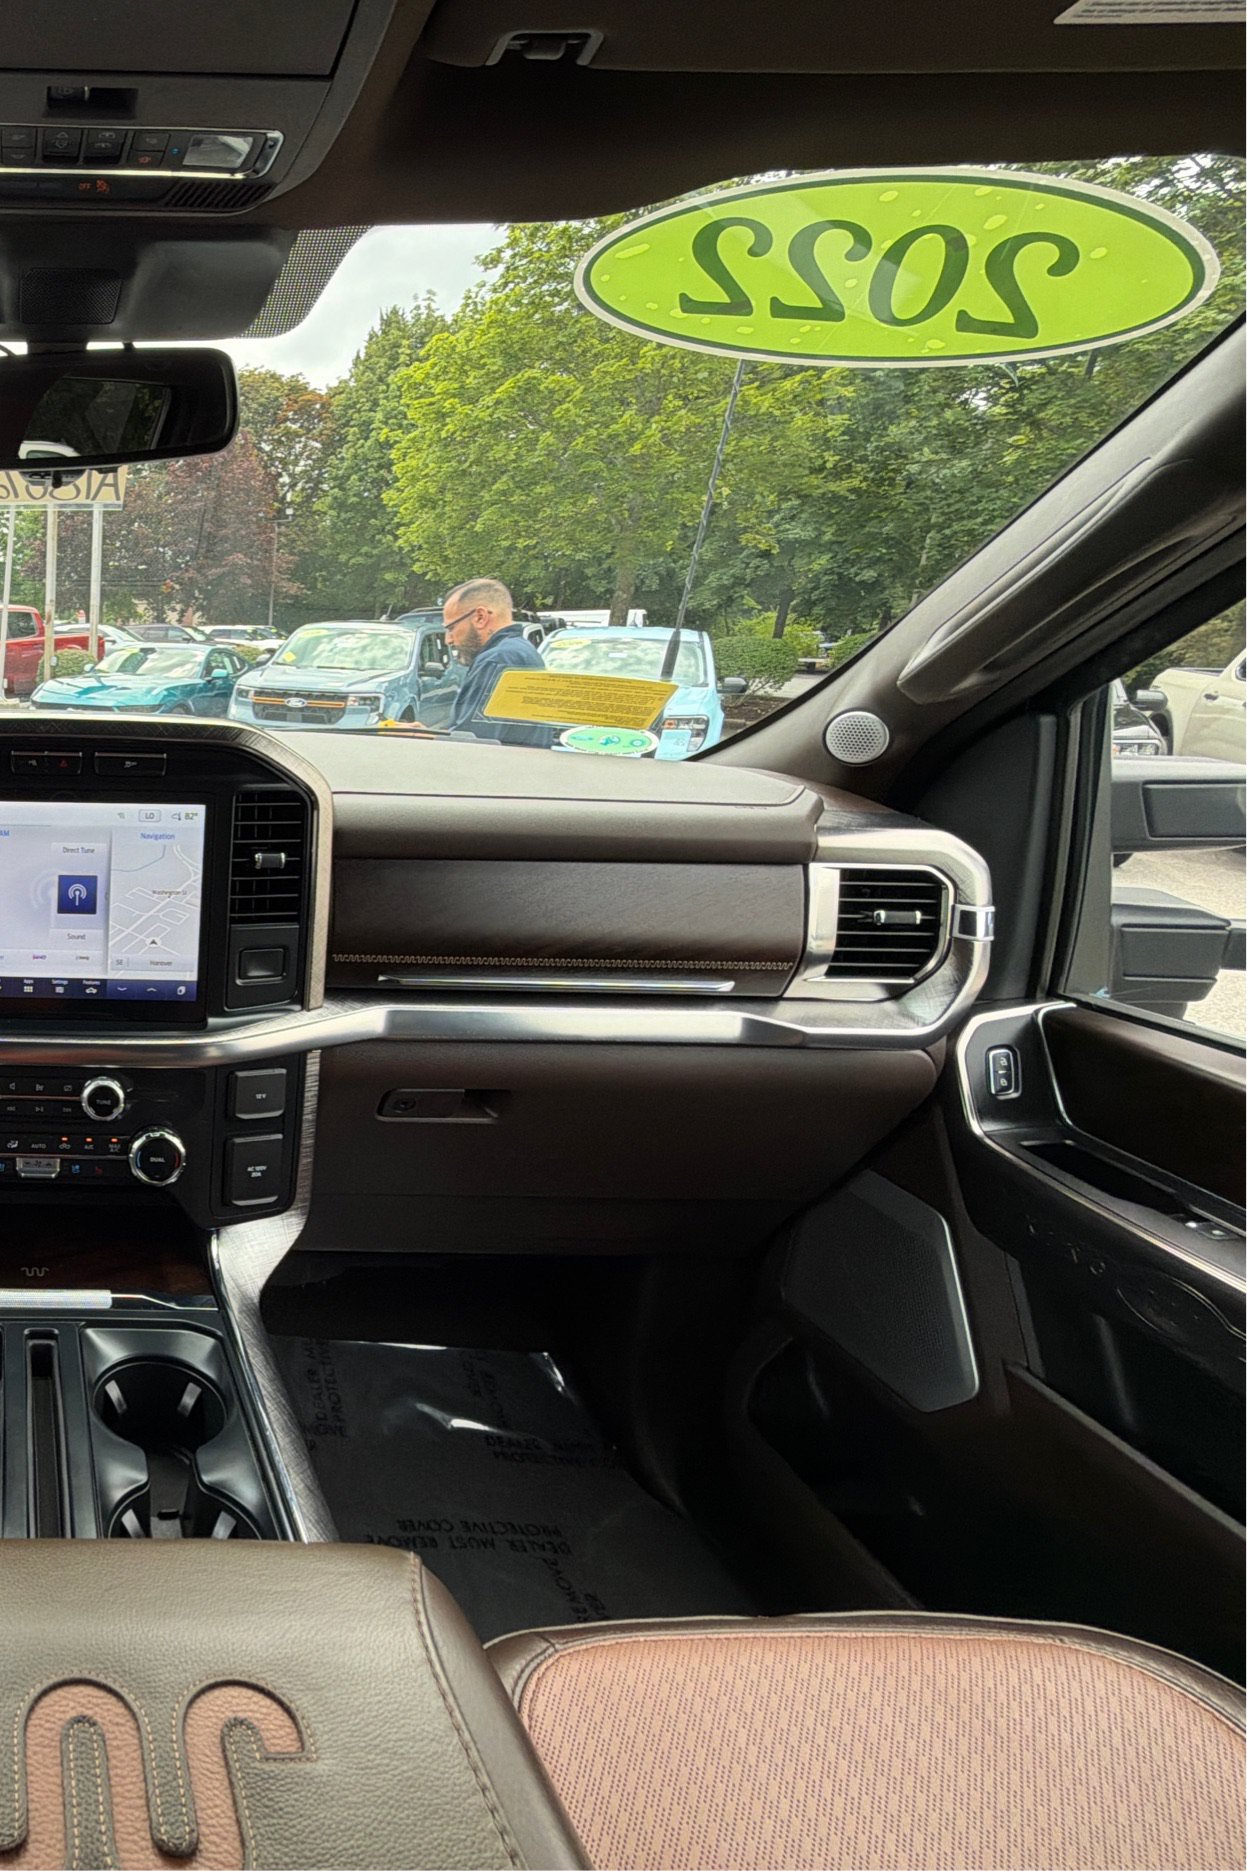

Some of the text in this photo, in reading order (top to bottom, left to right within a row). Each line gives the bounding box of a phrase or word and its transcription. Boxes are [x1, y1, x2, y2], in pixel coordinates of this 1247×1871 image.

[144, 812, 155, 820] LO
[140, 832, 176, 841] Navigation
[62, 846, 80, 854] Direct
[67, 932, 86, 941] Sound
[115, 958, 123, 967] SE
[31, 1142, 47, 1150] AUTO
[149, 1156, 167, 1164] DUAL
[395, 1518, 563, 1538] PROTECTIVE COVER
[448, 1535, 498, 1551] MUST
[506, 1539, 574, 1555] DEALER
